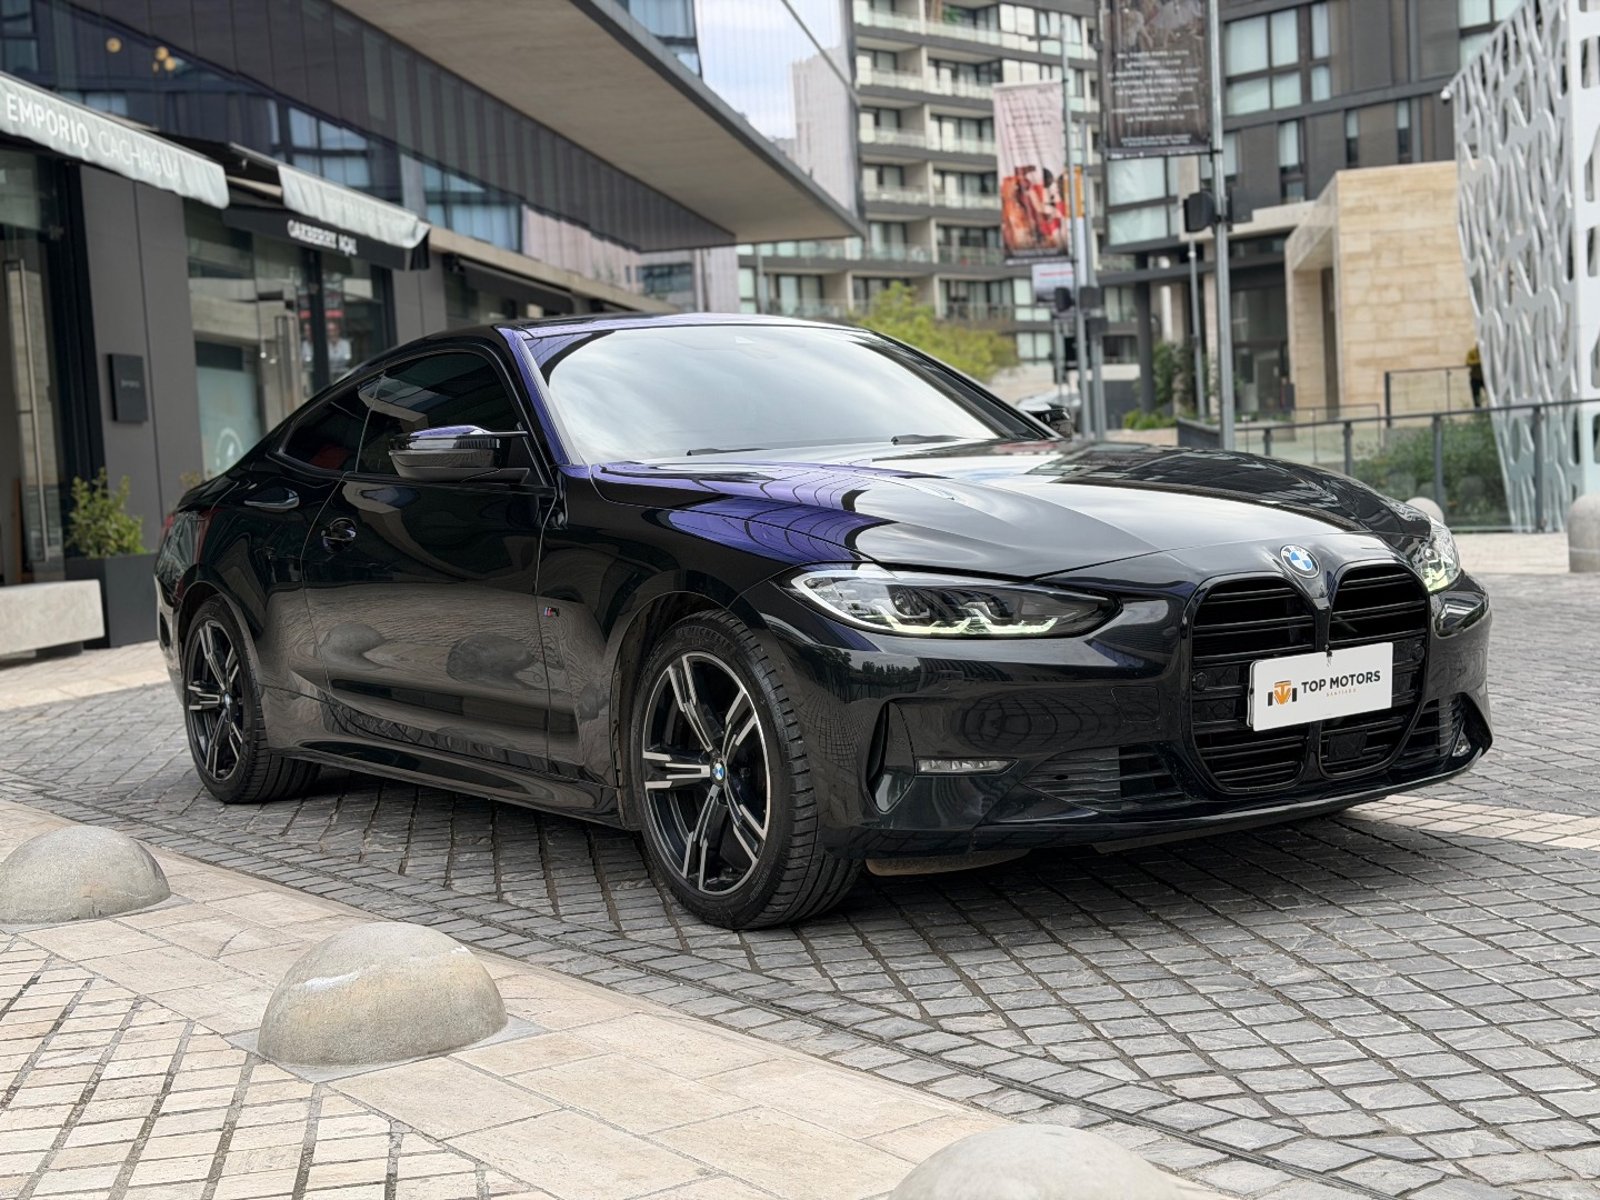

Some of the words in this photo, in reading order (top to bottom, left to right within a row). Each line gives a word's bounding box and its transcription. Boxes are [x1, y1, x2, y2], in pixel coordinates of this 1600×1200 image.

[6, 93, 89, 149] EMPORIO
[1301, 678, 1326, 693] TOP
[1329, 670, 1381, 689] MOTORS
